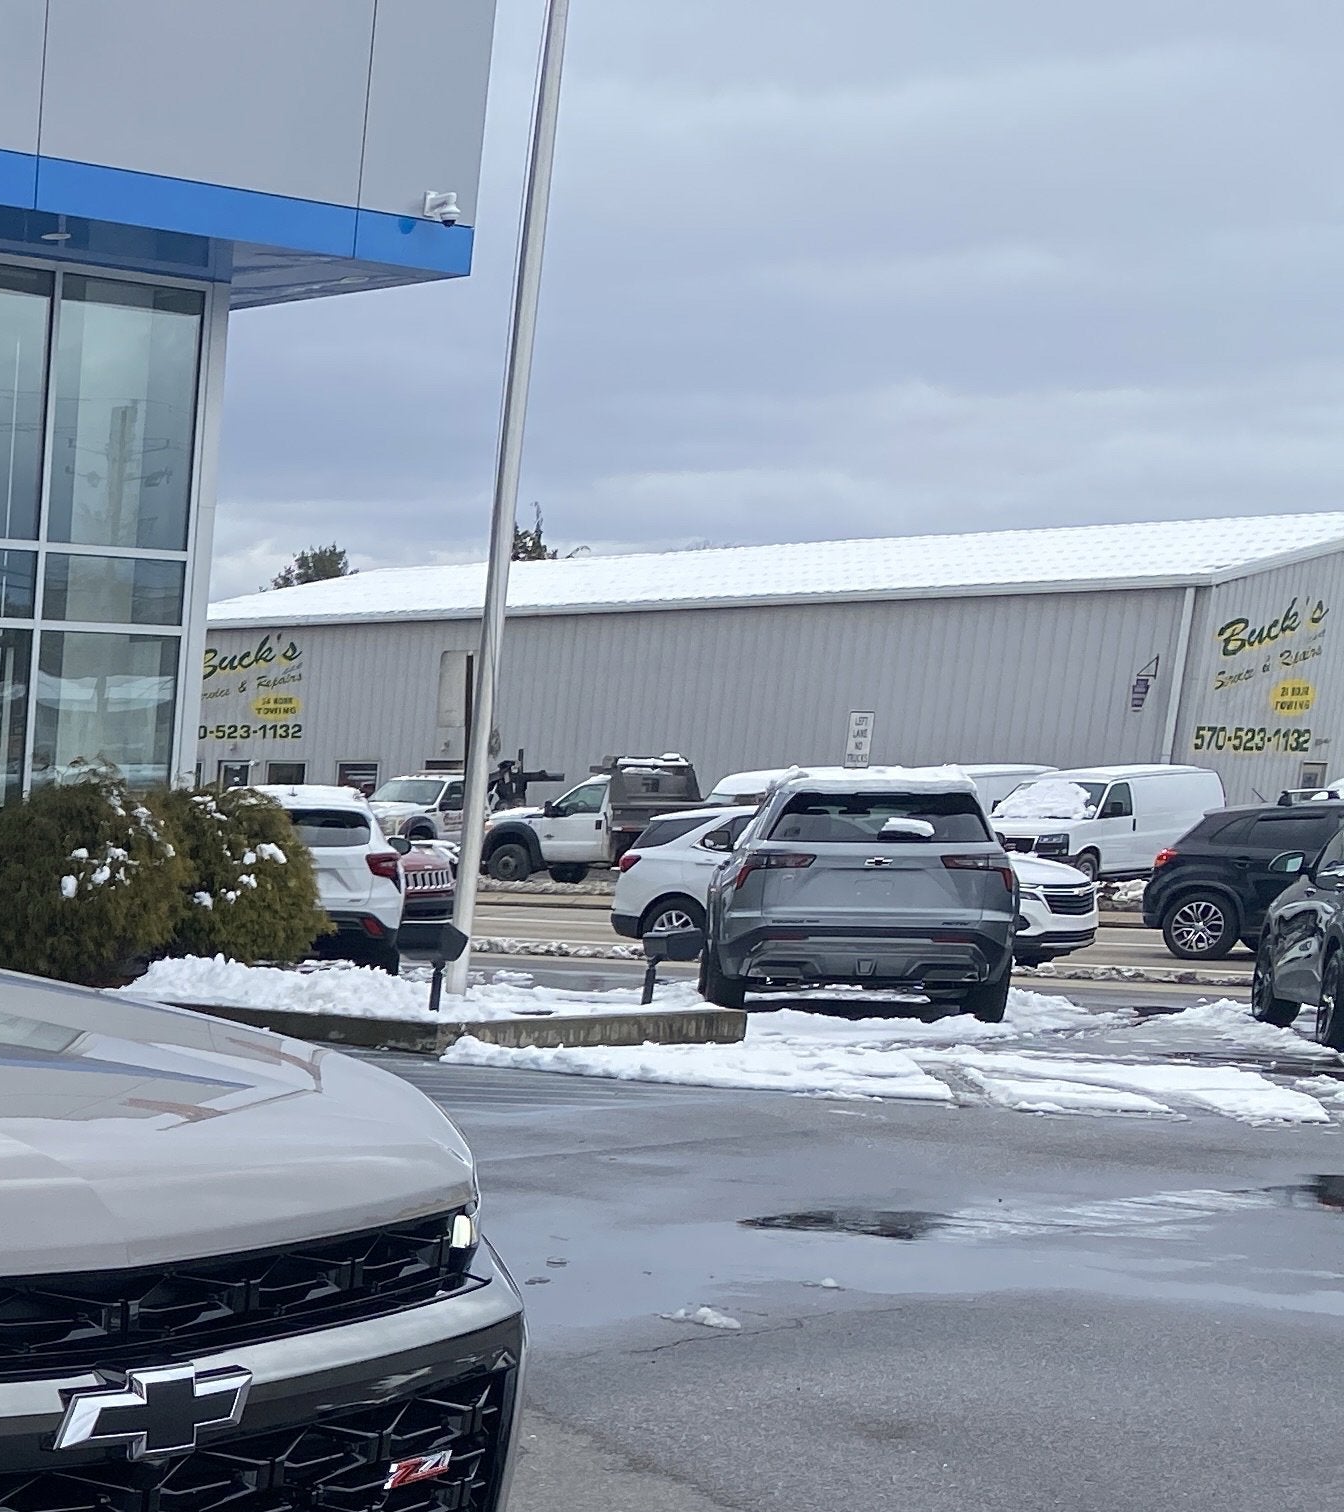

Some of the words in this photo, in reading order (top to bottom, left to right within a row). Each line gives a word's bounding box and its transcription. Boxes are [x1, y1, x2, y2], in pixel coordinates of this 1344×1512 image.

[1216, 595, 1330, 657] Buck's
[203, 633, 303, 680] Buck's
[238, 680, 248, 693] &
[256, 672, 302, 690] Repairs
[255, 706, 297, 715] TOWING
[1274, 700, 1311, 711] TOWING
[197, 723, 303, 740] 0-523-1132
[1193, 725, 1312, 752] 570-523-1132
[855, 742, 863, 750] NO
[383, 1449, 453, 1490] Z71
